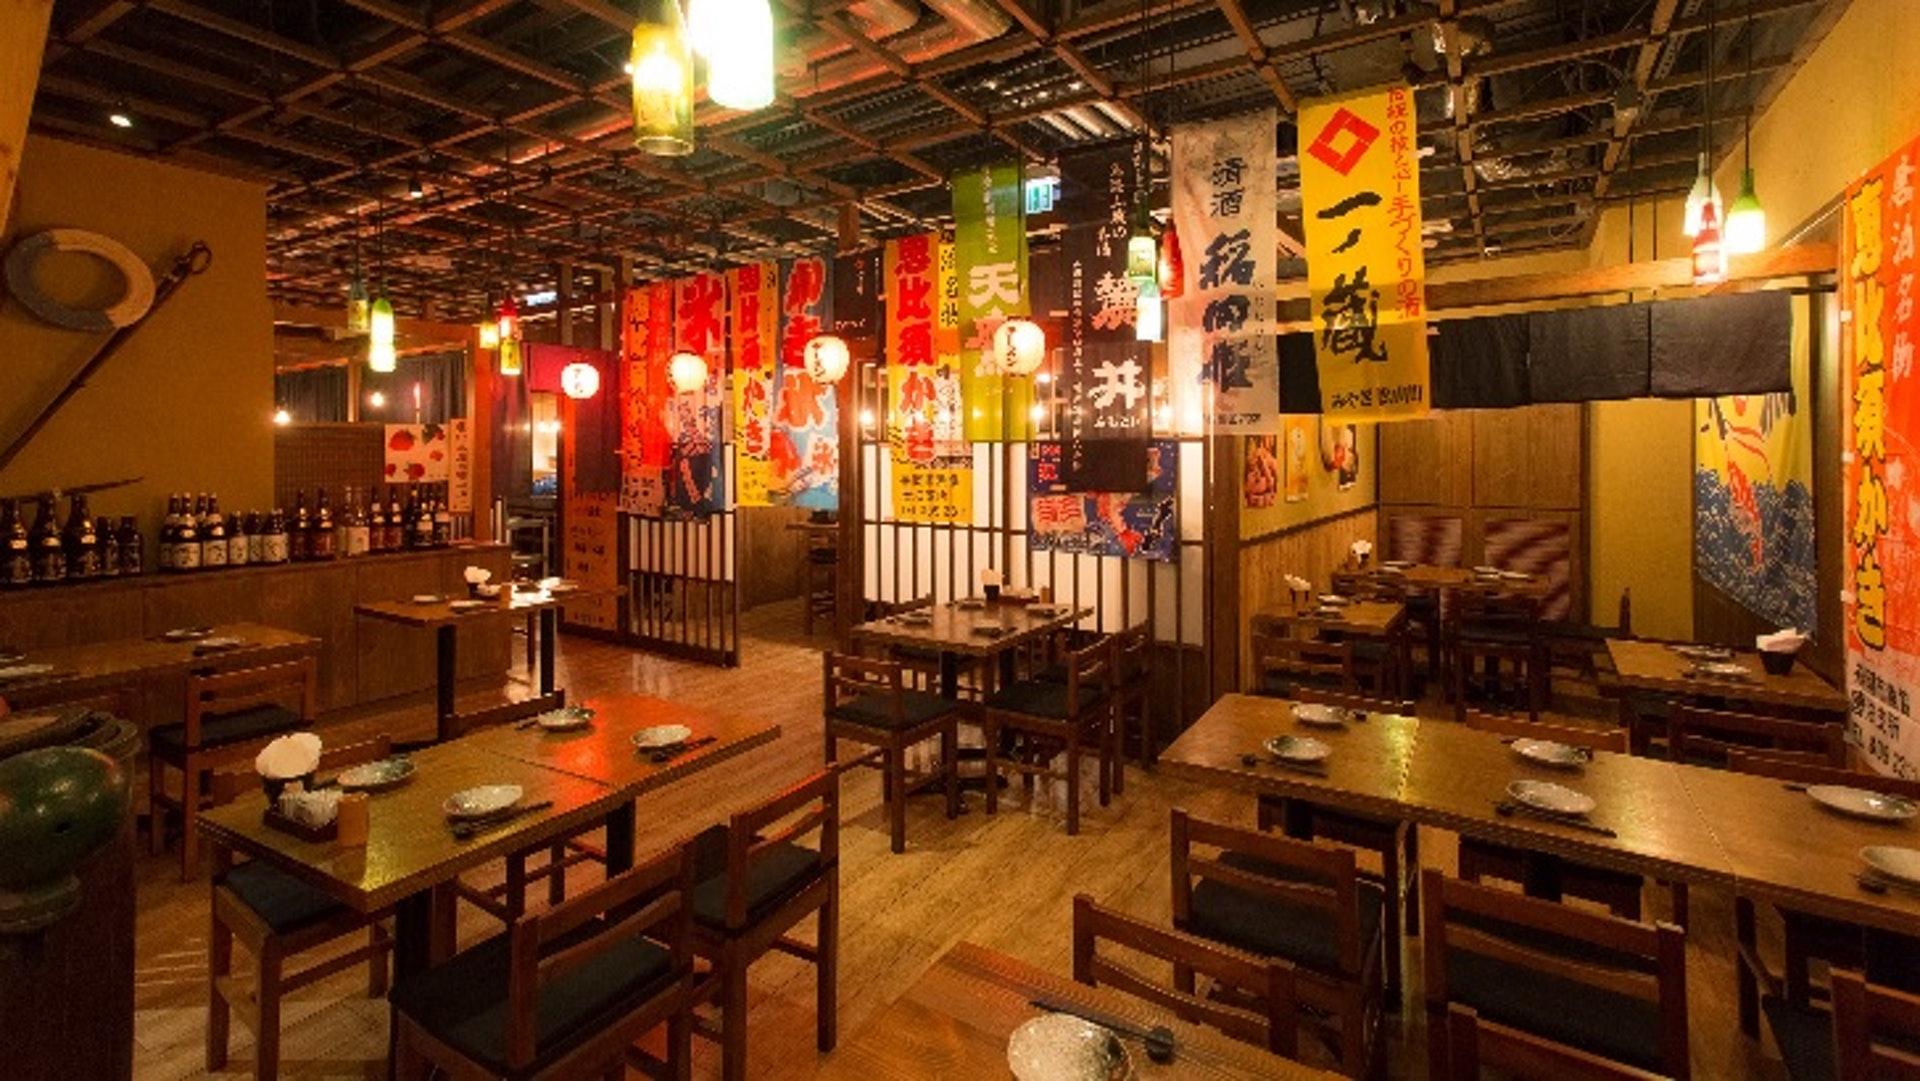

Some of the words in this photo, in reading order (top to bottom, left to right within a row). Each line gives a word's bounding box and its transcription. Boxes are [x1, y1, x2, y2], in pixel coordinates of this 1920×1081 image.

[1211, 156, 1248, 217] 清酒
[1316, 191, 1389, 364] 一ノ蔵
